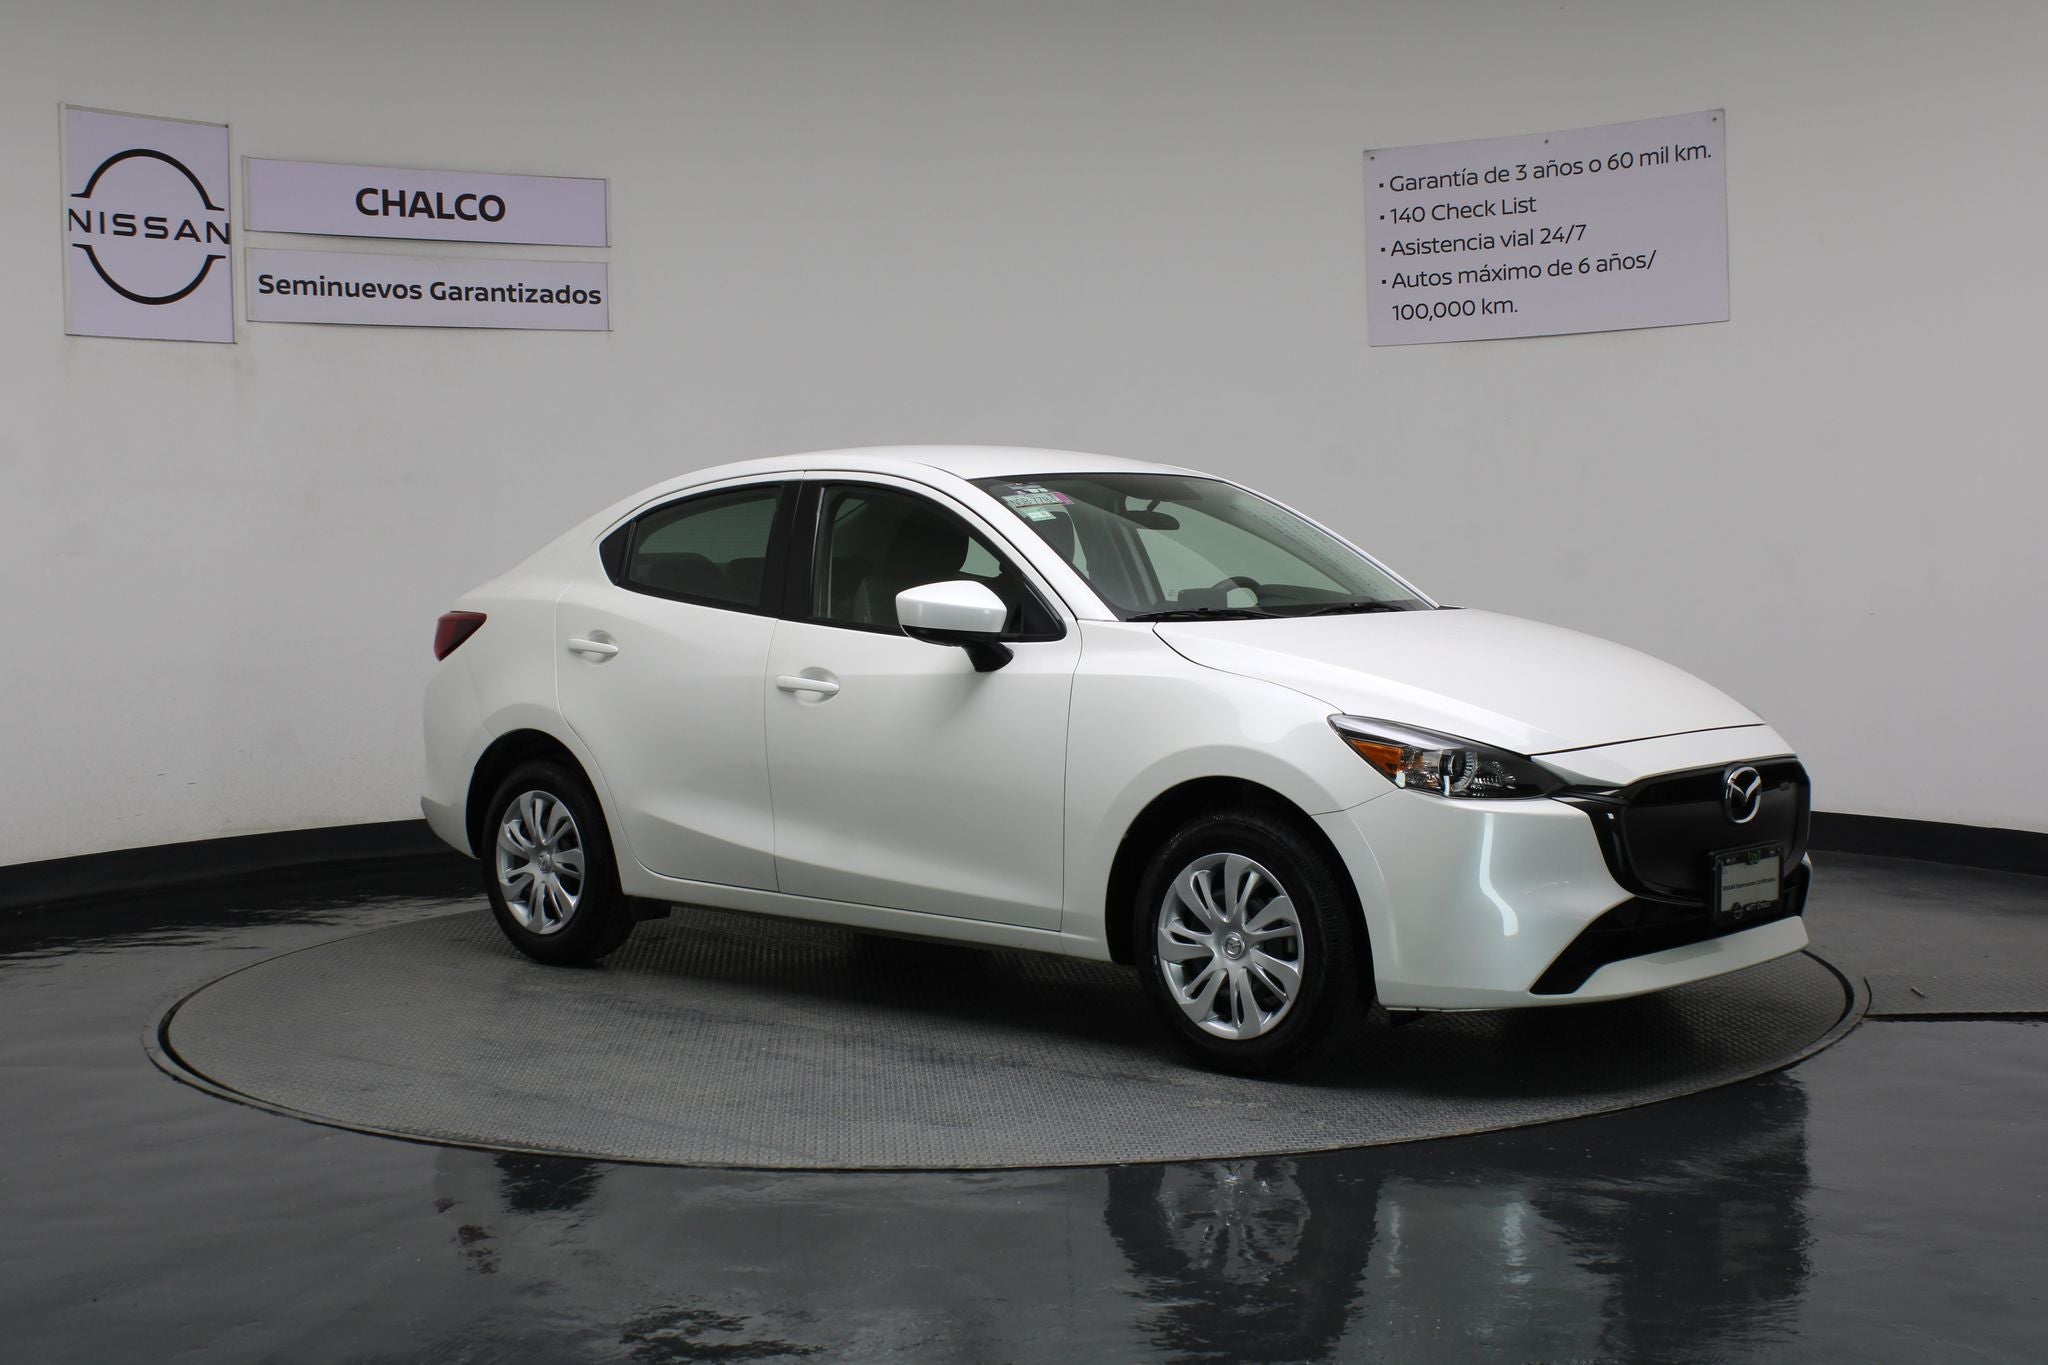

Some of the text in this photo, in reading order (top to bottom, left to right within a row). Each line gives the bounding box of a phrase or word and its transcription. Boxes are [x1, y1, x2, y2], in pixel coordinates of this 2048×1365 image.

[1389, 143, 1712, 193] Garantía de 3 años o 60 mil km.
[355, 187, 506, 223] CHALCO
[1389, 196, 1538, 225] 140 Check List
[68, 207, 233, 247] NISSAN
[1390, 223, 1587, 257] Asistencia vial 24/7
[1391, 249, 1657, 290] Autos máximo de 6 años/
[258, 274, 603, 305] Seminuevos Garantizados
[1391, 297, 1518, 321] 100,000 km.
